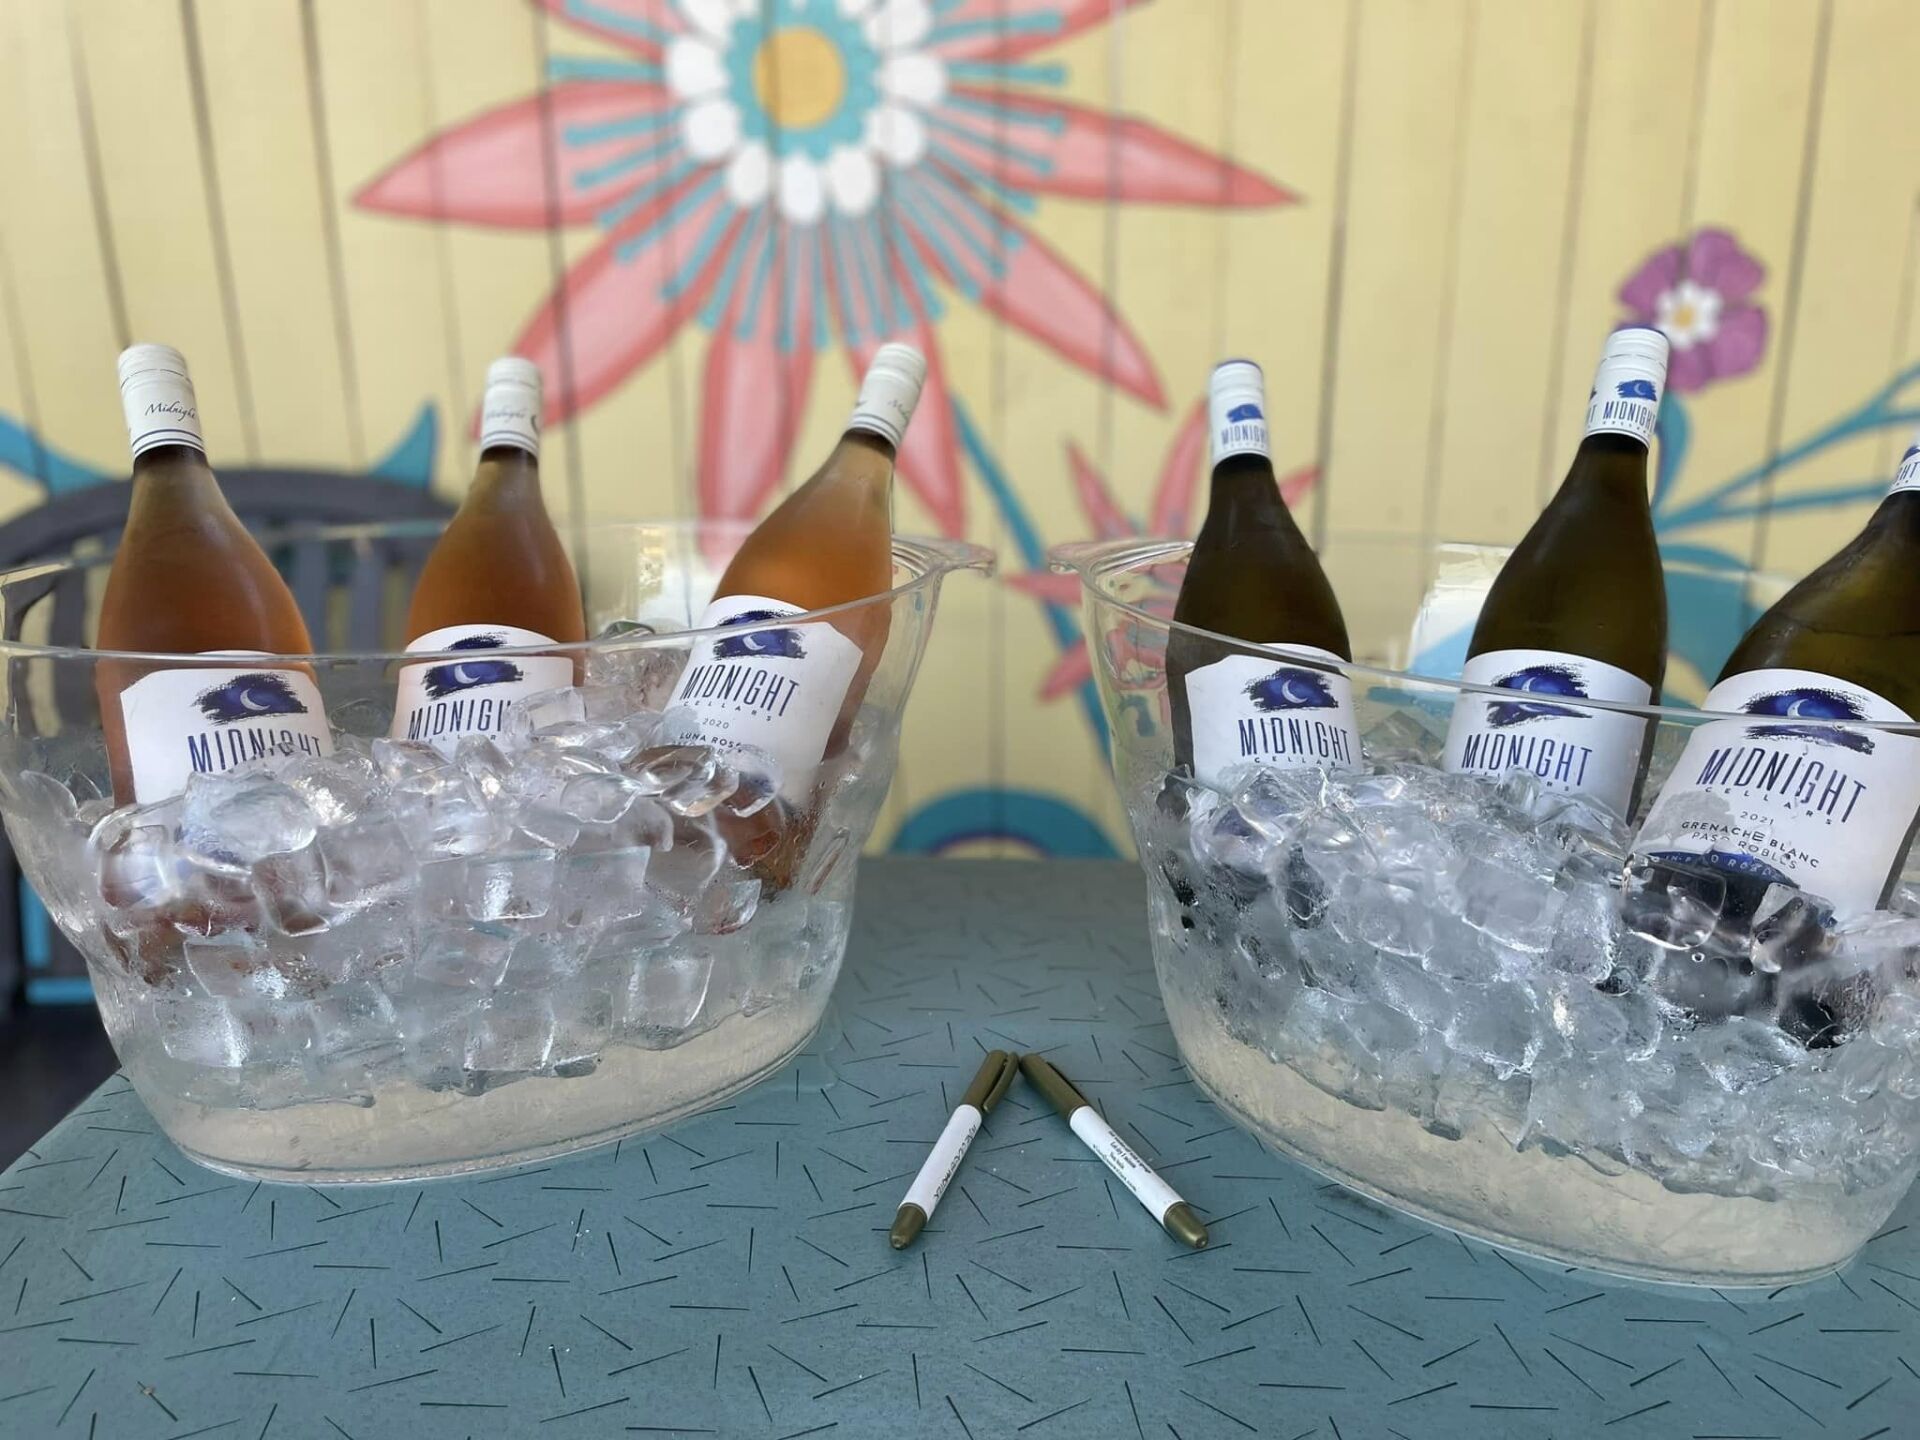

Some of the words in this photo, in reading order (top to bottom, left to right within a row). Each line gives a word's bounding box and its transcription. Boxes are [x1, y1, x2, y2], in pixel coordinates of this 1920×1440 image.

[680, 664, 799, 717] MIDNIGHT
[684, 701, 772, 722] CELLARS
[702, 718, 730, 729] 2020
[680, 732, 707, 742] LUNA
[1238, 717, 1351, 764] MIDNIGHT
[1254, 756, 1336, 766] CELLAR
[1461, 733, 1592, 786] MIDNIGHT
[1696, 747, 1867, 823] MIDNIGHT
[1705, 786, 1832, 825] CELLARS
[1740, 810, 1774, 825] 2021
[1681, 821, 1765, 842] GRENACHE
[1769, 839, 1820, 868] BLANC
